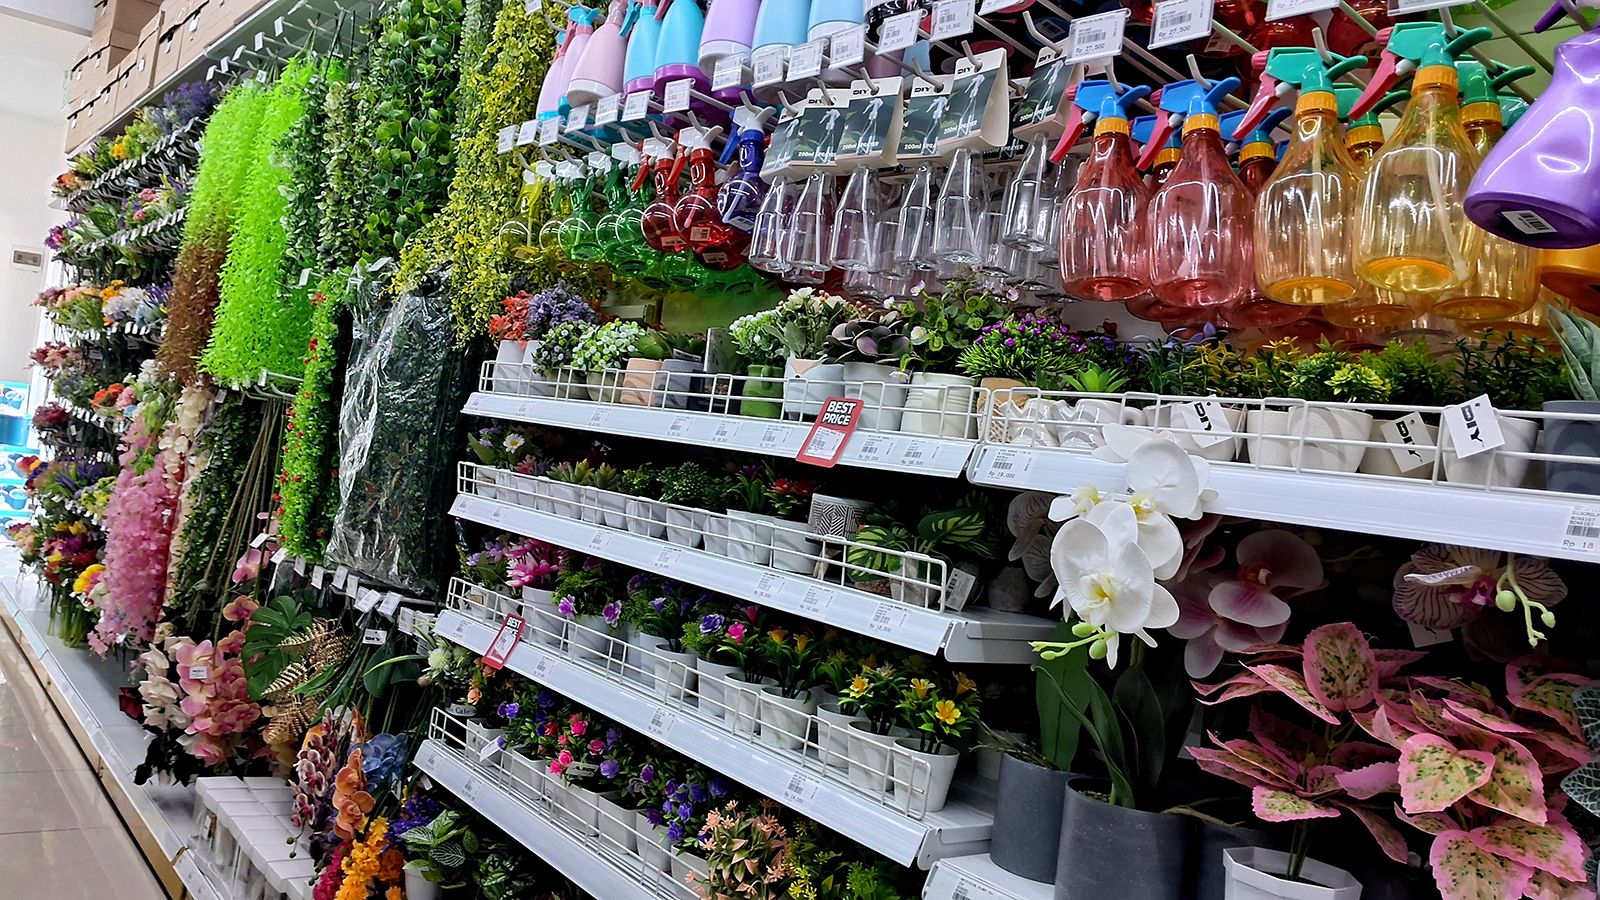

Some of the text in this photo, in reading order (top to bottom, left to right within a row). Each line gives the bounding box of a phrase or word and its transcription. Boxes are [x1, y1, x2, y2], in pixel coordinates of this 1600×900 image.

[957, 66, 973, 74] DIY
[827, 401, 857, 414] BEST
[822, 413, 851, 425] PRICE
[1461, 404, 1483, 443] DIY
[1563, 539, 1575, 550] Rp
[507, 616, 522, 629] BEST
